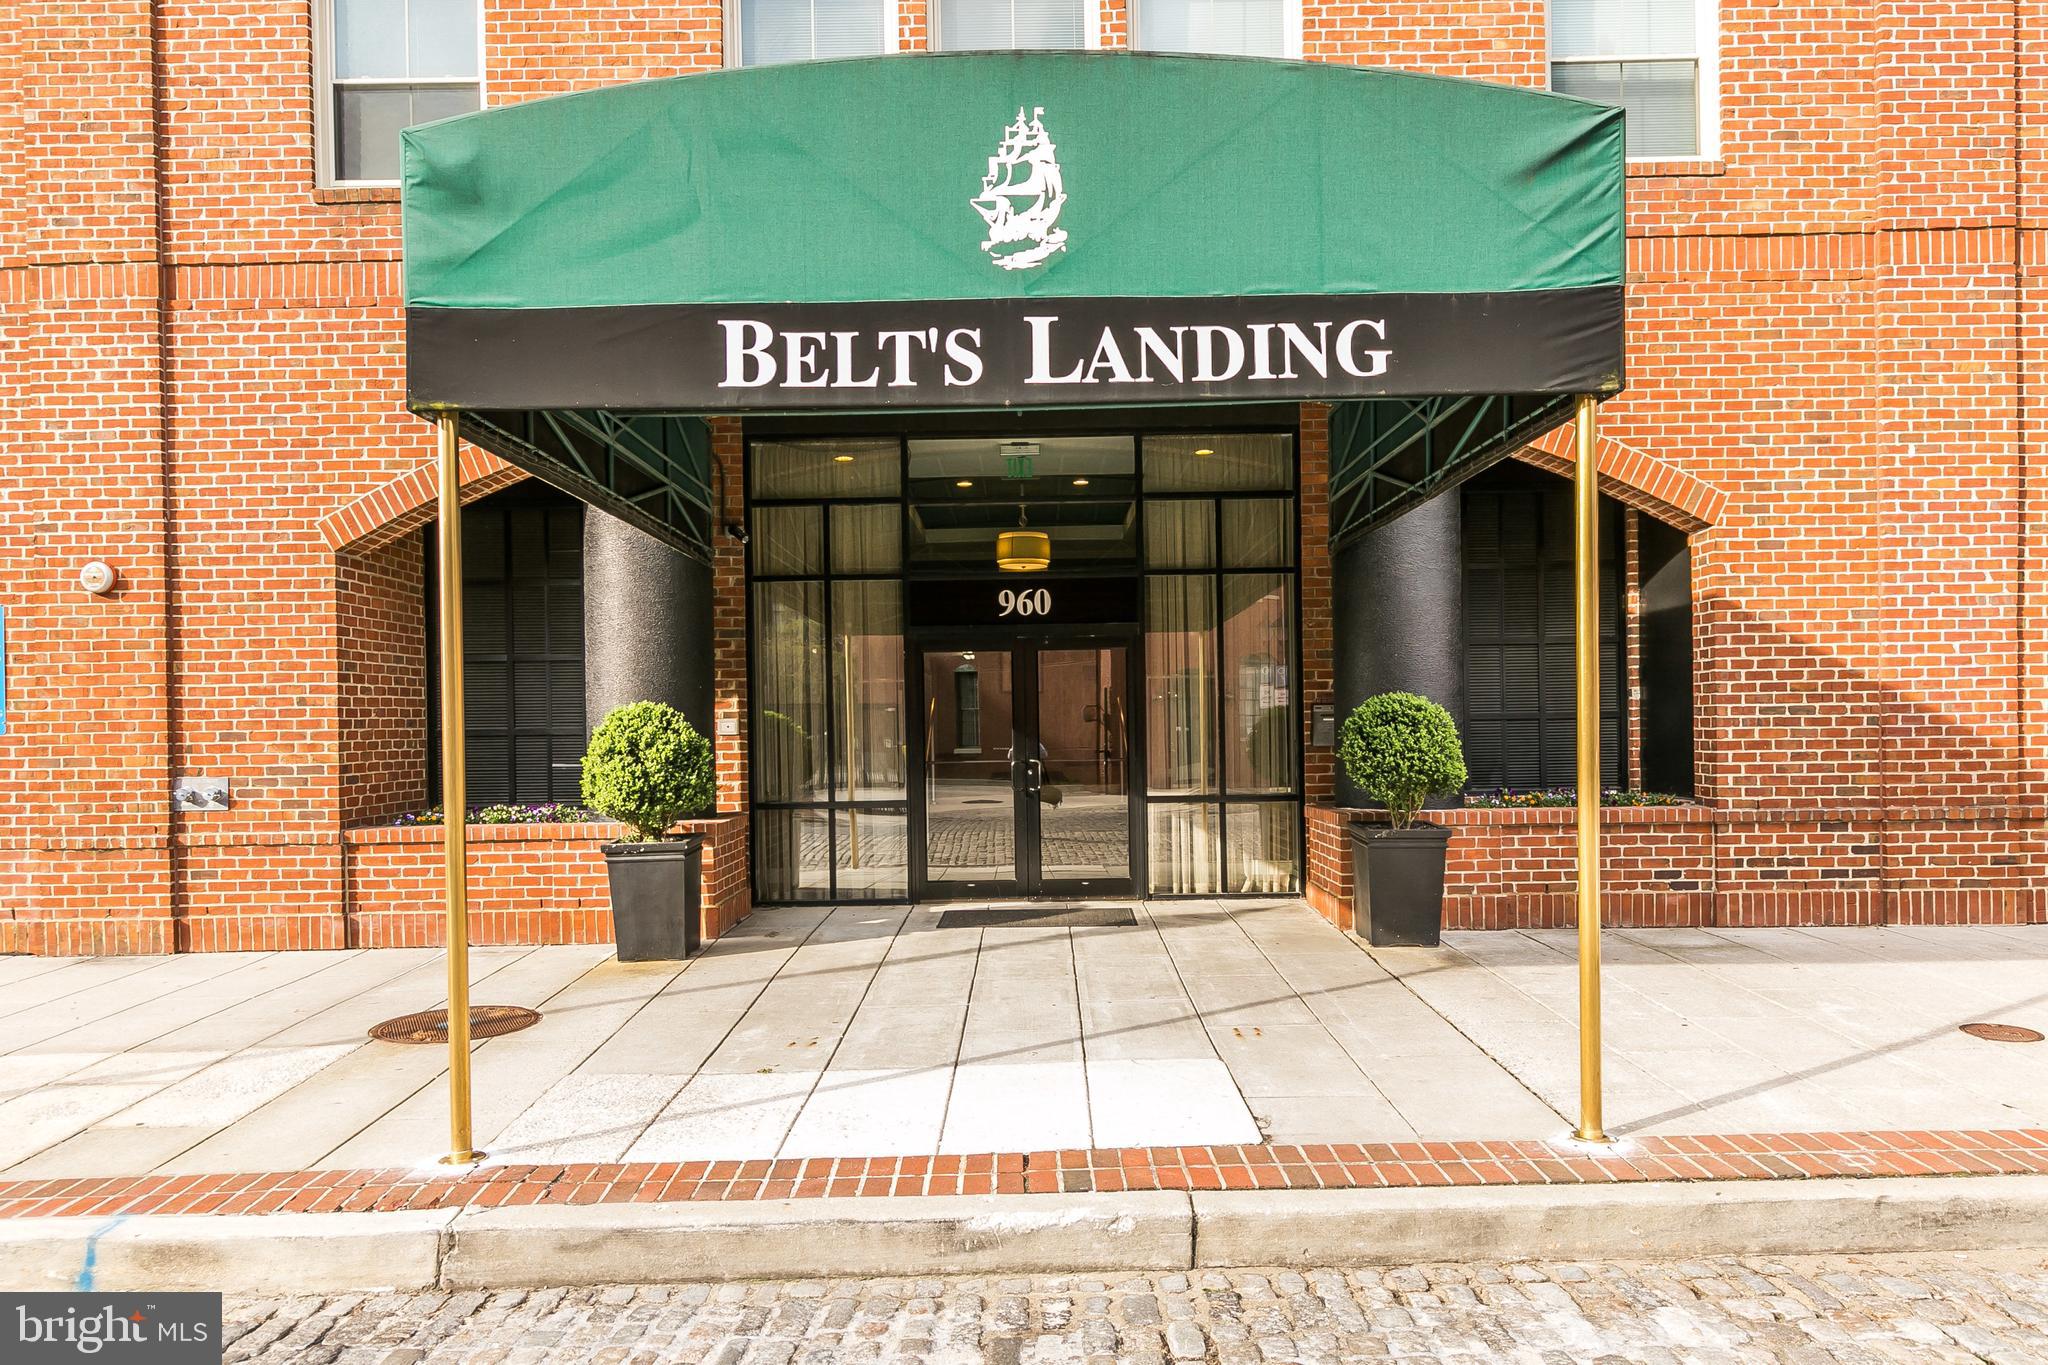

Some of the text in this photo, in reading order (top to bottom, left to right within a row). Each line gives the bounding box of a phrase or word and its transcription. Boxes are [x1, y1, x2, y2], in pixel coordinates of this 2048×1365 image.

[717, 315, 1393, 388] BELT'S LANDING
[998, 588, 1052, 617] 960
